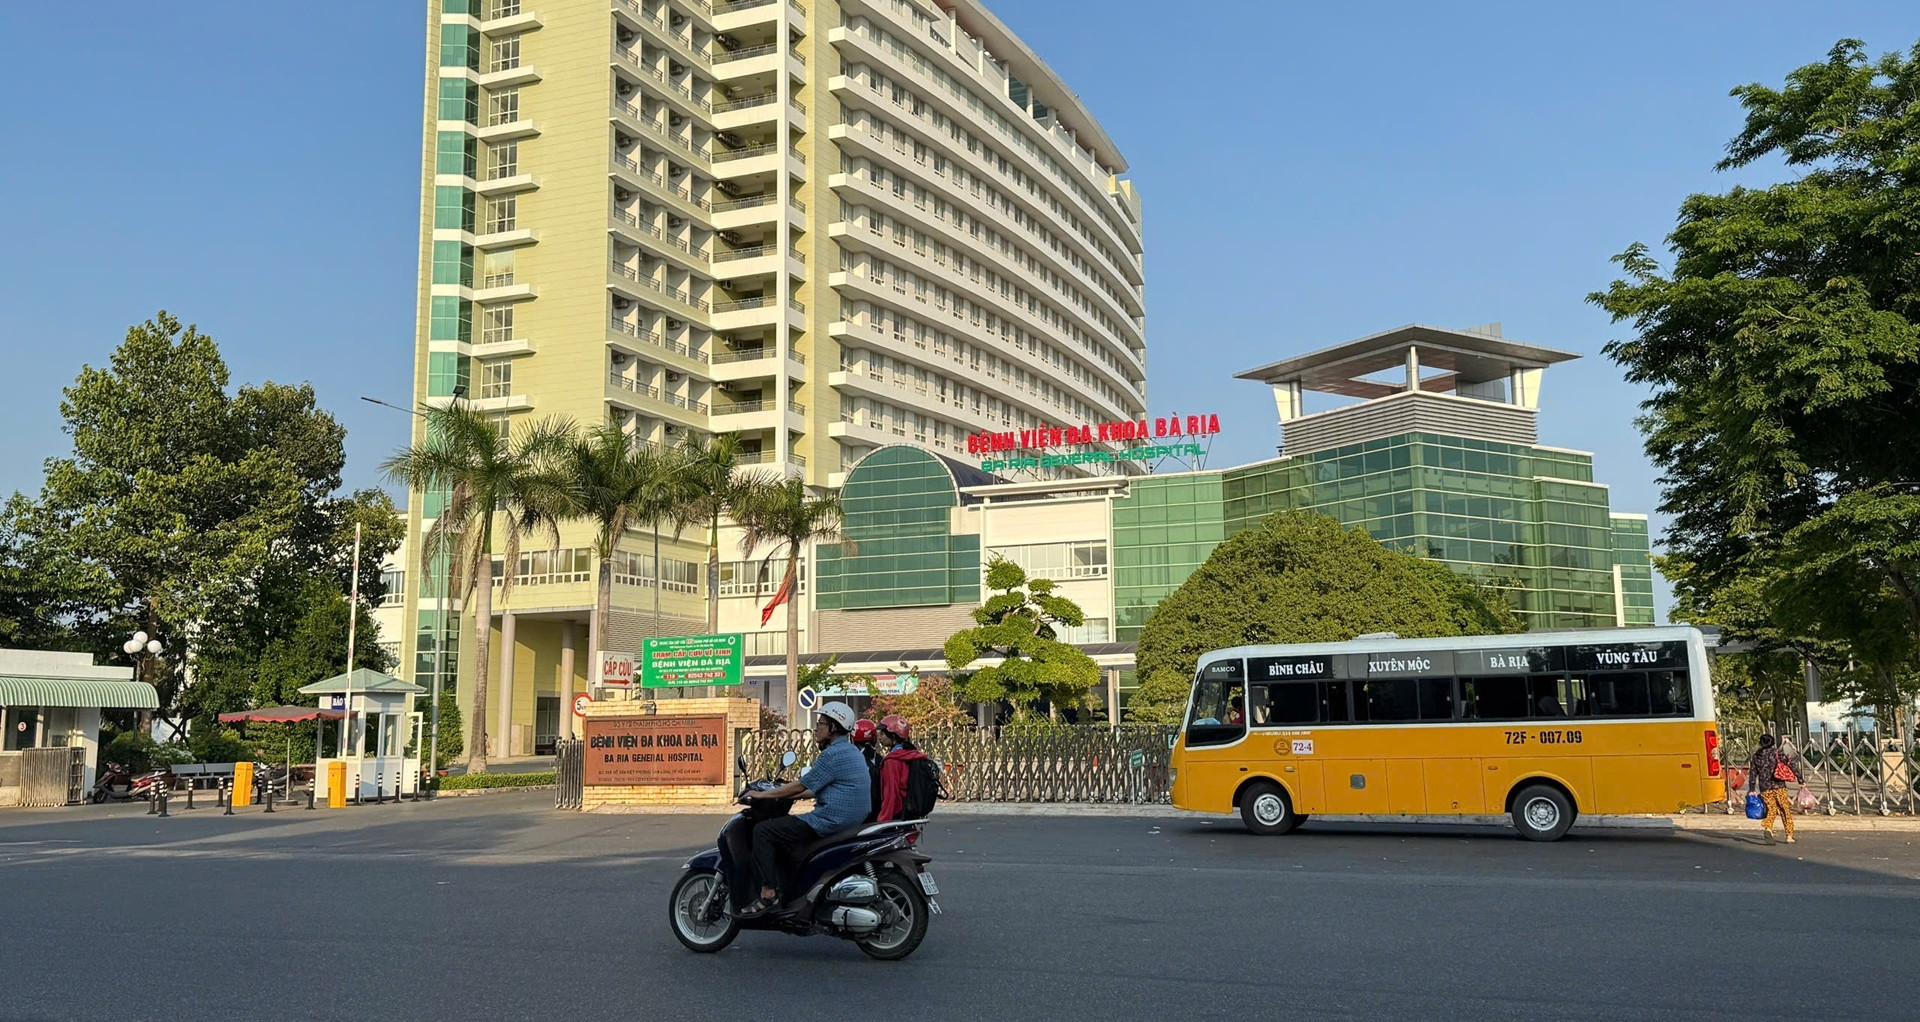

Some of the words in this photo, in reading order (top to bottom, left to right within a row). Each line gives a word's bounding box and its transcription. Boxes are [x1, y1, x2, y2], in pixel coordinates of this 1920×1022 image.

[968, 429, 1014, 455] BỆNH
[1020, 423, 1062, 452] VIỆN
[1067, 424, 1092, 444] ĐA
[1098, 419, 1148, 442] KHOA
[1155, 412, 1181, 437] BÀ
[1187, 414, 1221, 438] RỊA
[1008, 457, 1036, 470] RIA
[1040, 450, 1115, 468] GENERAL
[1120, 443, 1206, 462] HOSPITAL
[652, 660, 676, 669] BỆNH
[678, 659, 698, 668] VIỆN
[701, 658, 713, 666] BÀ
[716, 658, 731, 666] RỊA
[1490, 654, 1506, 668] BÀ
[1508, 655, 1530, 670] RỊA
[1596, 650, 1630, 664] VŨNG
[1632, 648, 1657, 664] TÀU
[604, 656, 617, 675] CẤP
[619, 658, 632, 676] CỨU
[1268, 662, 1294, 676] BÌNH
[1296, 660, 1324, 674] CHÂU
[1368, 658, 1405, 672] XUYÊN
[1408, 656, 1430, 674] MỘC
[591, 734, 614, 750] BỆNH
[618, 733, 638, 750] VIỆN
[641, 734, 654, 748] ĐA
[657, 734, 682, 747] KHOA
[685, 732, 698, 747] BÀ
[701, 733, 718, 748] RỊA
[1505, 731, 1527, 744] 72F
[1540, 731, 1582, 744] 007.09
[1294, 742, 1312, 751] 72-4
[604, 754, 614, 763] BA
[617, 754, 629, 763] RIA
[632, 753, 664, 762] GENERAL
[668, 753, 703, 762] HOSPITAL
